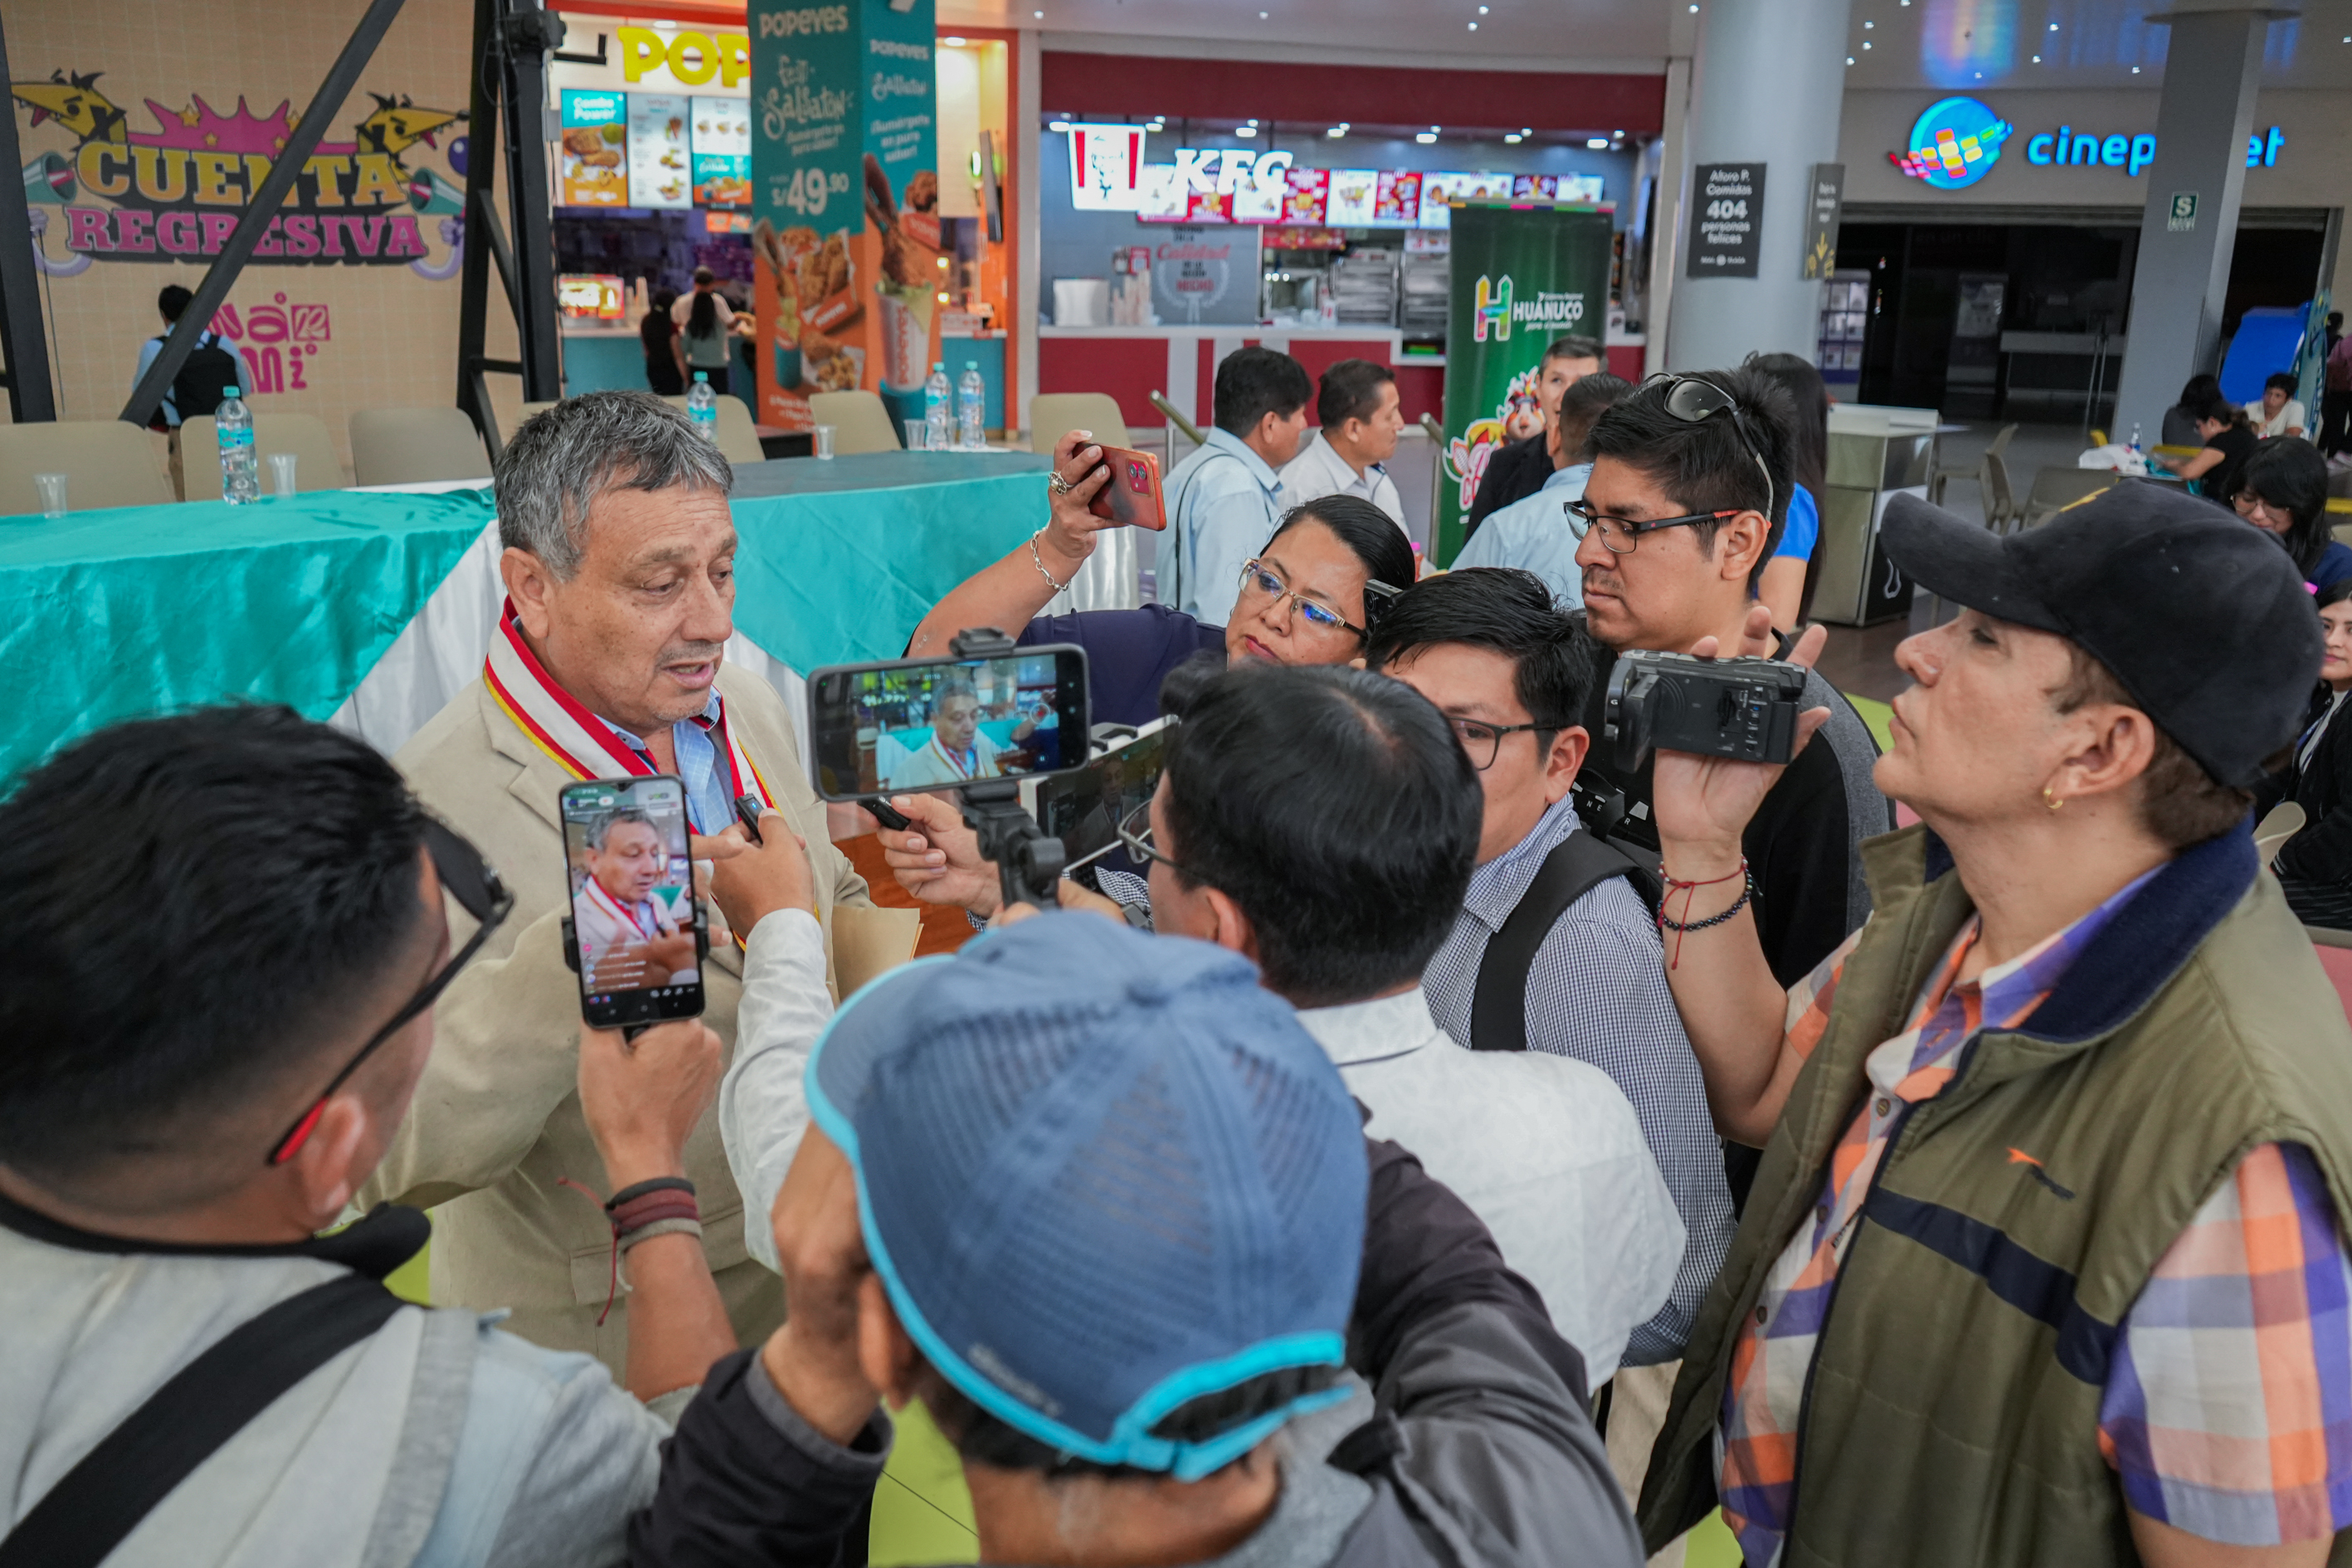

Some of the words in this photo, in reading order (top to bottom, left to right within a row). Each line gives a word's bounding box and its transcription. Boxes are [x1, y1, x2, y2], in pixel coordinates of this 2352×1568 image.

[1168, 149, 1293, 195] KFC
[1709, 169, 1740, 183] Aforo
[1706, 183, 1752, 196] Comidas
[1707, 199, 1748, 219] 404
[2175, 197, 2193, 217] S
[66, 206, 428, 257] REGRESIVA
[1702, 221, 1751, 234] personas
[1707, 231, 1742, 245] felices
[1512, 295, 1584, 321] HUÁNUCO
